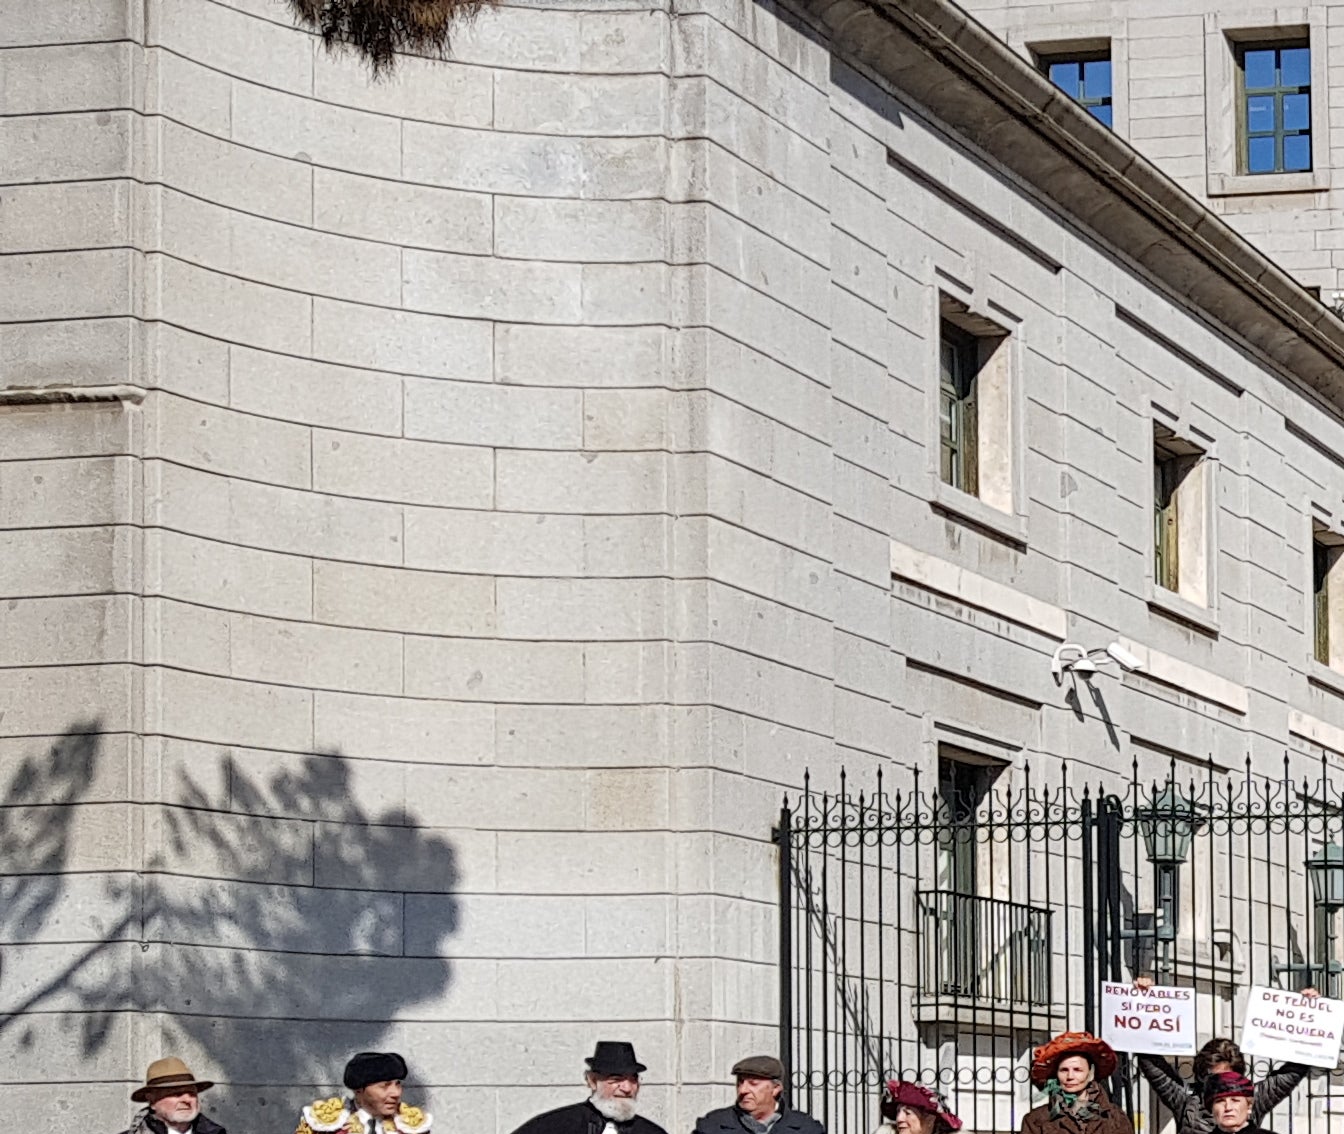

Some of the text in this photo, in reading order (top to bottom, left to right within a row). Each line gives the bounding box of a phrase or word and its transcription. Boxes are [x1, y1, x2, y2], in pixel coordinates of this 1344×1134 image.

[1105, 985, 1190, 1001] RENOVABLES
[1263, 992, 1280, 1003] DE
[1136, 1003, 1172, 1014] PERO
[1276, 1008, 1315, 1023] NO ES
[1114, 1014, 1181, 1032] NO ASÍ
[1251, 1017, 1335, 1040] CUALQUIERA
